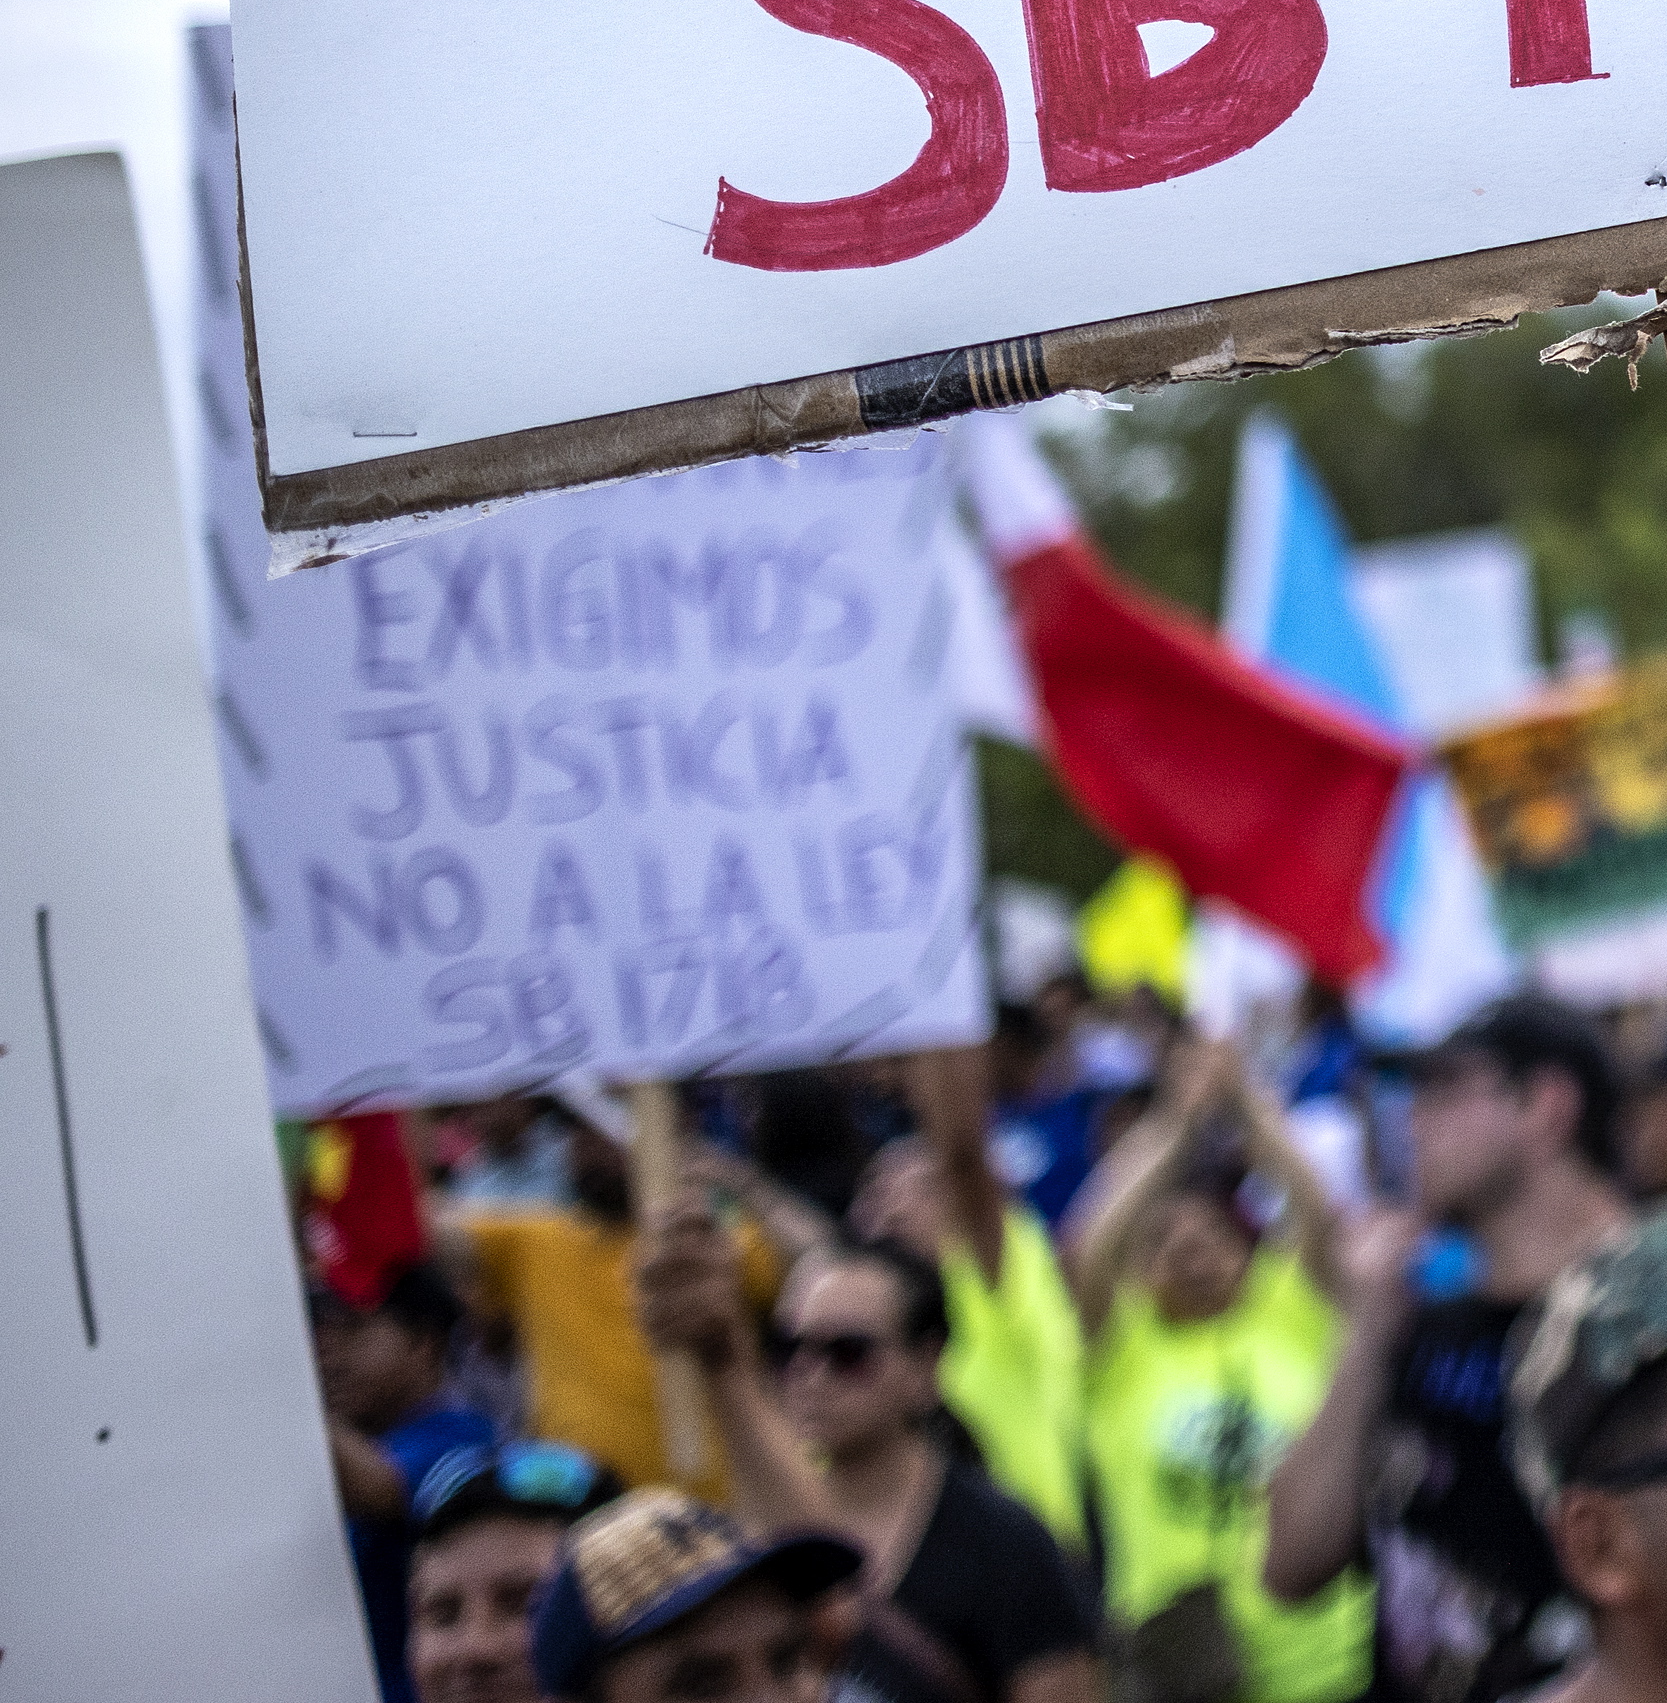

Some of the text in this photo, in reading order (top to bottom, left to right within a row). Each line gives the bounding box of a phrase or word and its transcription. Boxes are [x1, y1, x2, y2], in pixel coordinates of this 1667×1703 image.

[348, 519, 880, 694] EXIGIMOS
[336, 690, 860, 844] JUSTICIA
[300, 809, 945, 965] NO A LA LEY
[416, 919, 816, 1075] SB 1718
